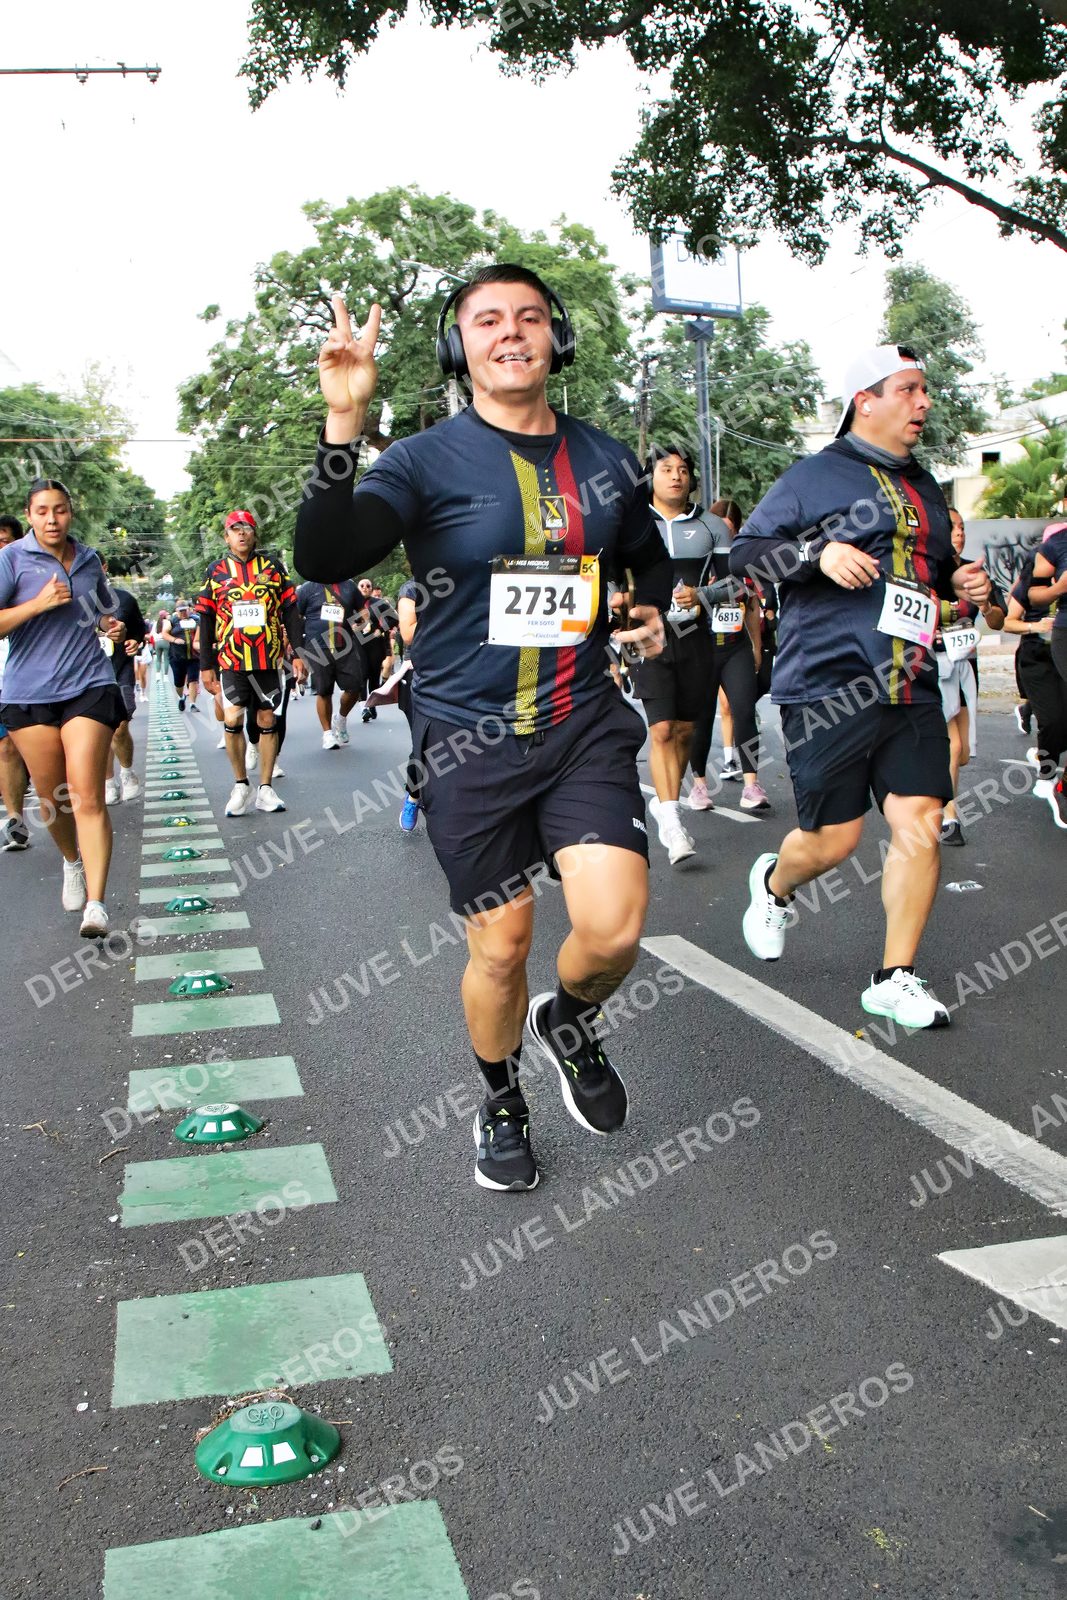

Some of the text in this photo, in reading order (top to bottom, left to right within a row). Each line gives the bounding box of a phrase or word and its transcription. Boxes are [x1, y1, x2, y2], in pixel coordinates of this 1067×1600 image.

[582, 564, 594, 573] 5K
[505, 586, 576, 615] 2734
[237, 608, 259, 617] 4493
[894, 593, 930, 623] 9221
[718, 612, 740, 622] 6815
[950, 633, 975, 647] 7579
